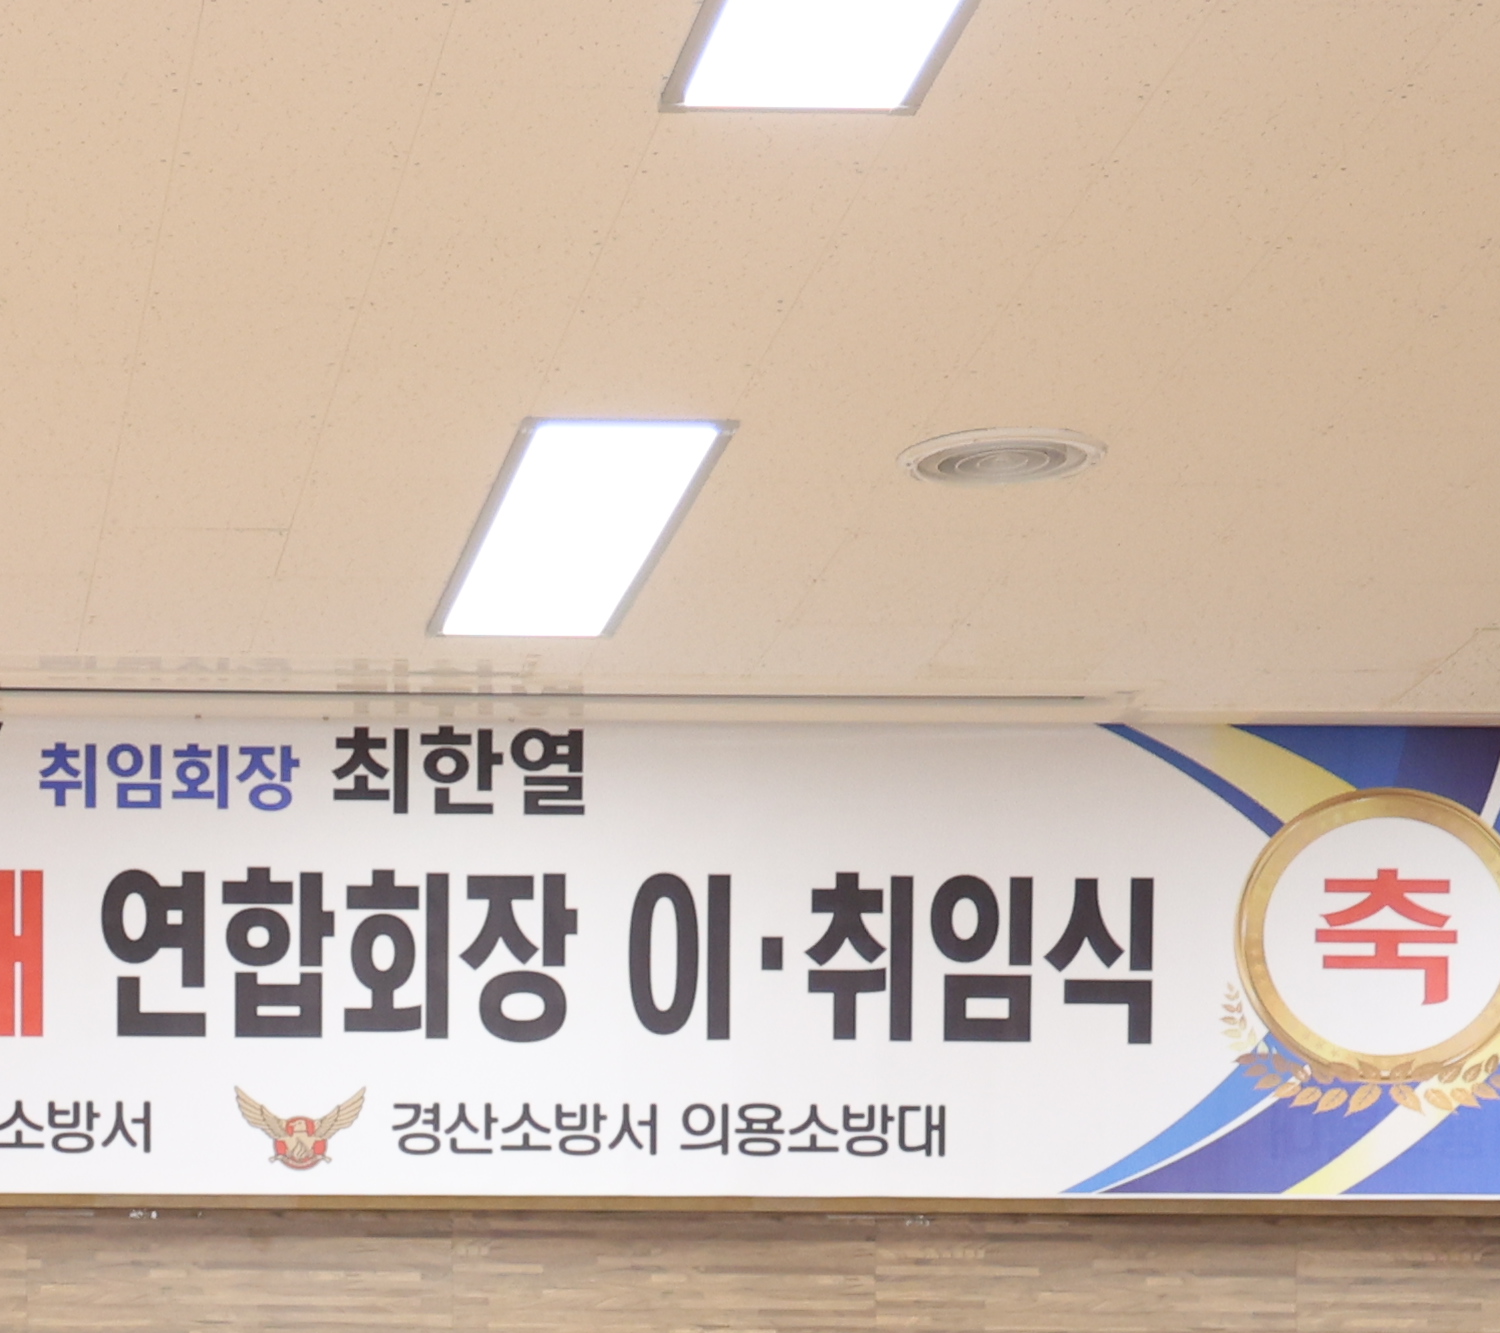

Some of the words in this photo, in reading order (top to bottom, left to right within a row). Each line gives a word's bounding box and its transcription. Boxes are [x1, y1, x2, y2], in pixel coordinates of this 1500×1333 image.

[38, 742, 301, 812] 취임회장
[332, 725, 586, 815] 최한열
[100, 866, 578, 1043] 연합회장
[1314, 868, 1458, 1005] 축
[391, 1101, 659, 1157] 경산소방서
[679, 1102, 947, 1158] 의용소방대
